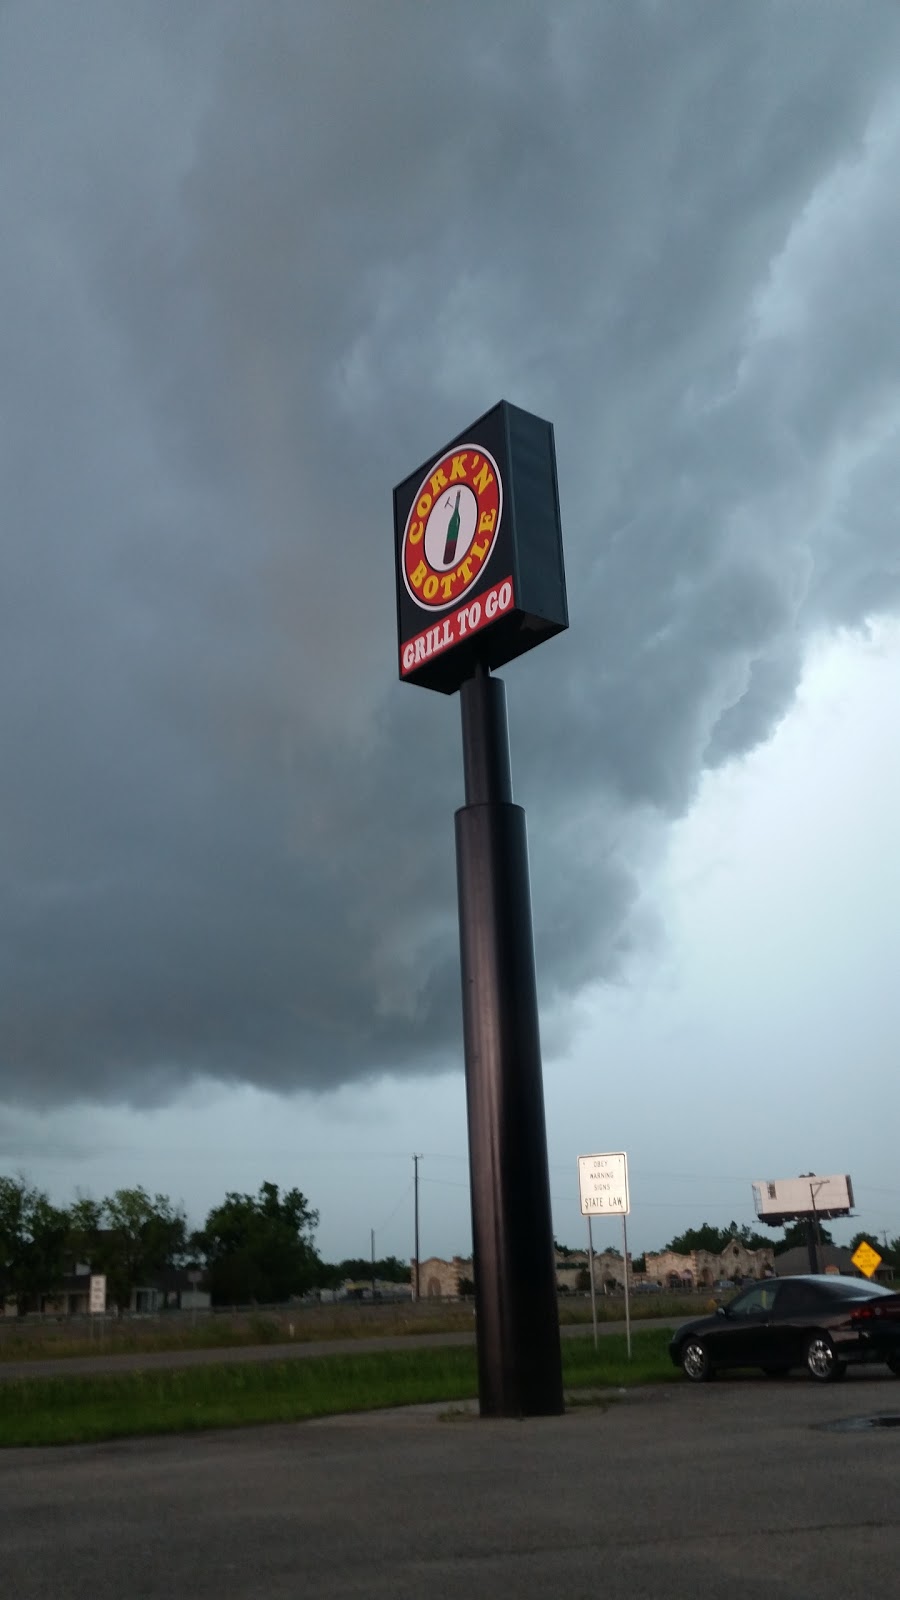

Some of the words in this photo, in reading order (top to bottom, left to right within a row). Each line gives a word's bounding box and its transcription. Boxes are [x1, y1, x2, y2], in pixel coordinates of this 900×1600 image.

[408, 453, 494, 545] CORK'N
[409, 508, 497, 600] BOTTLE
[402, 619, 454, 670] GRILL
[457, 600, 481, 636] TO
[485, 582, 512, 618] GO
[584, 1197, 603, 1207] STATE
[608, 1196, 623, 1206] LAW
[589, 1171, 614, 1179] WARNING
